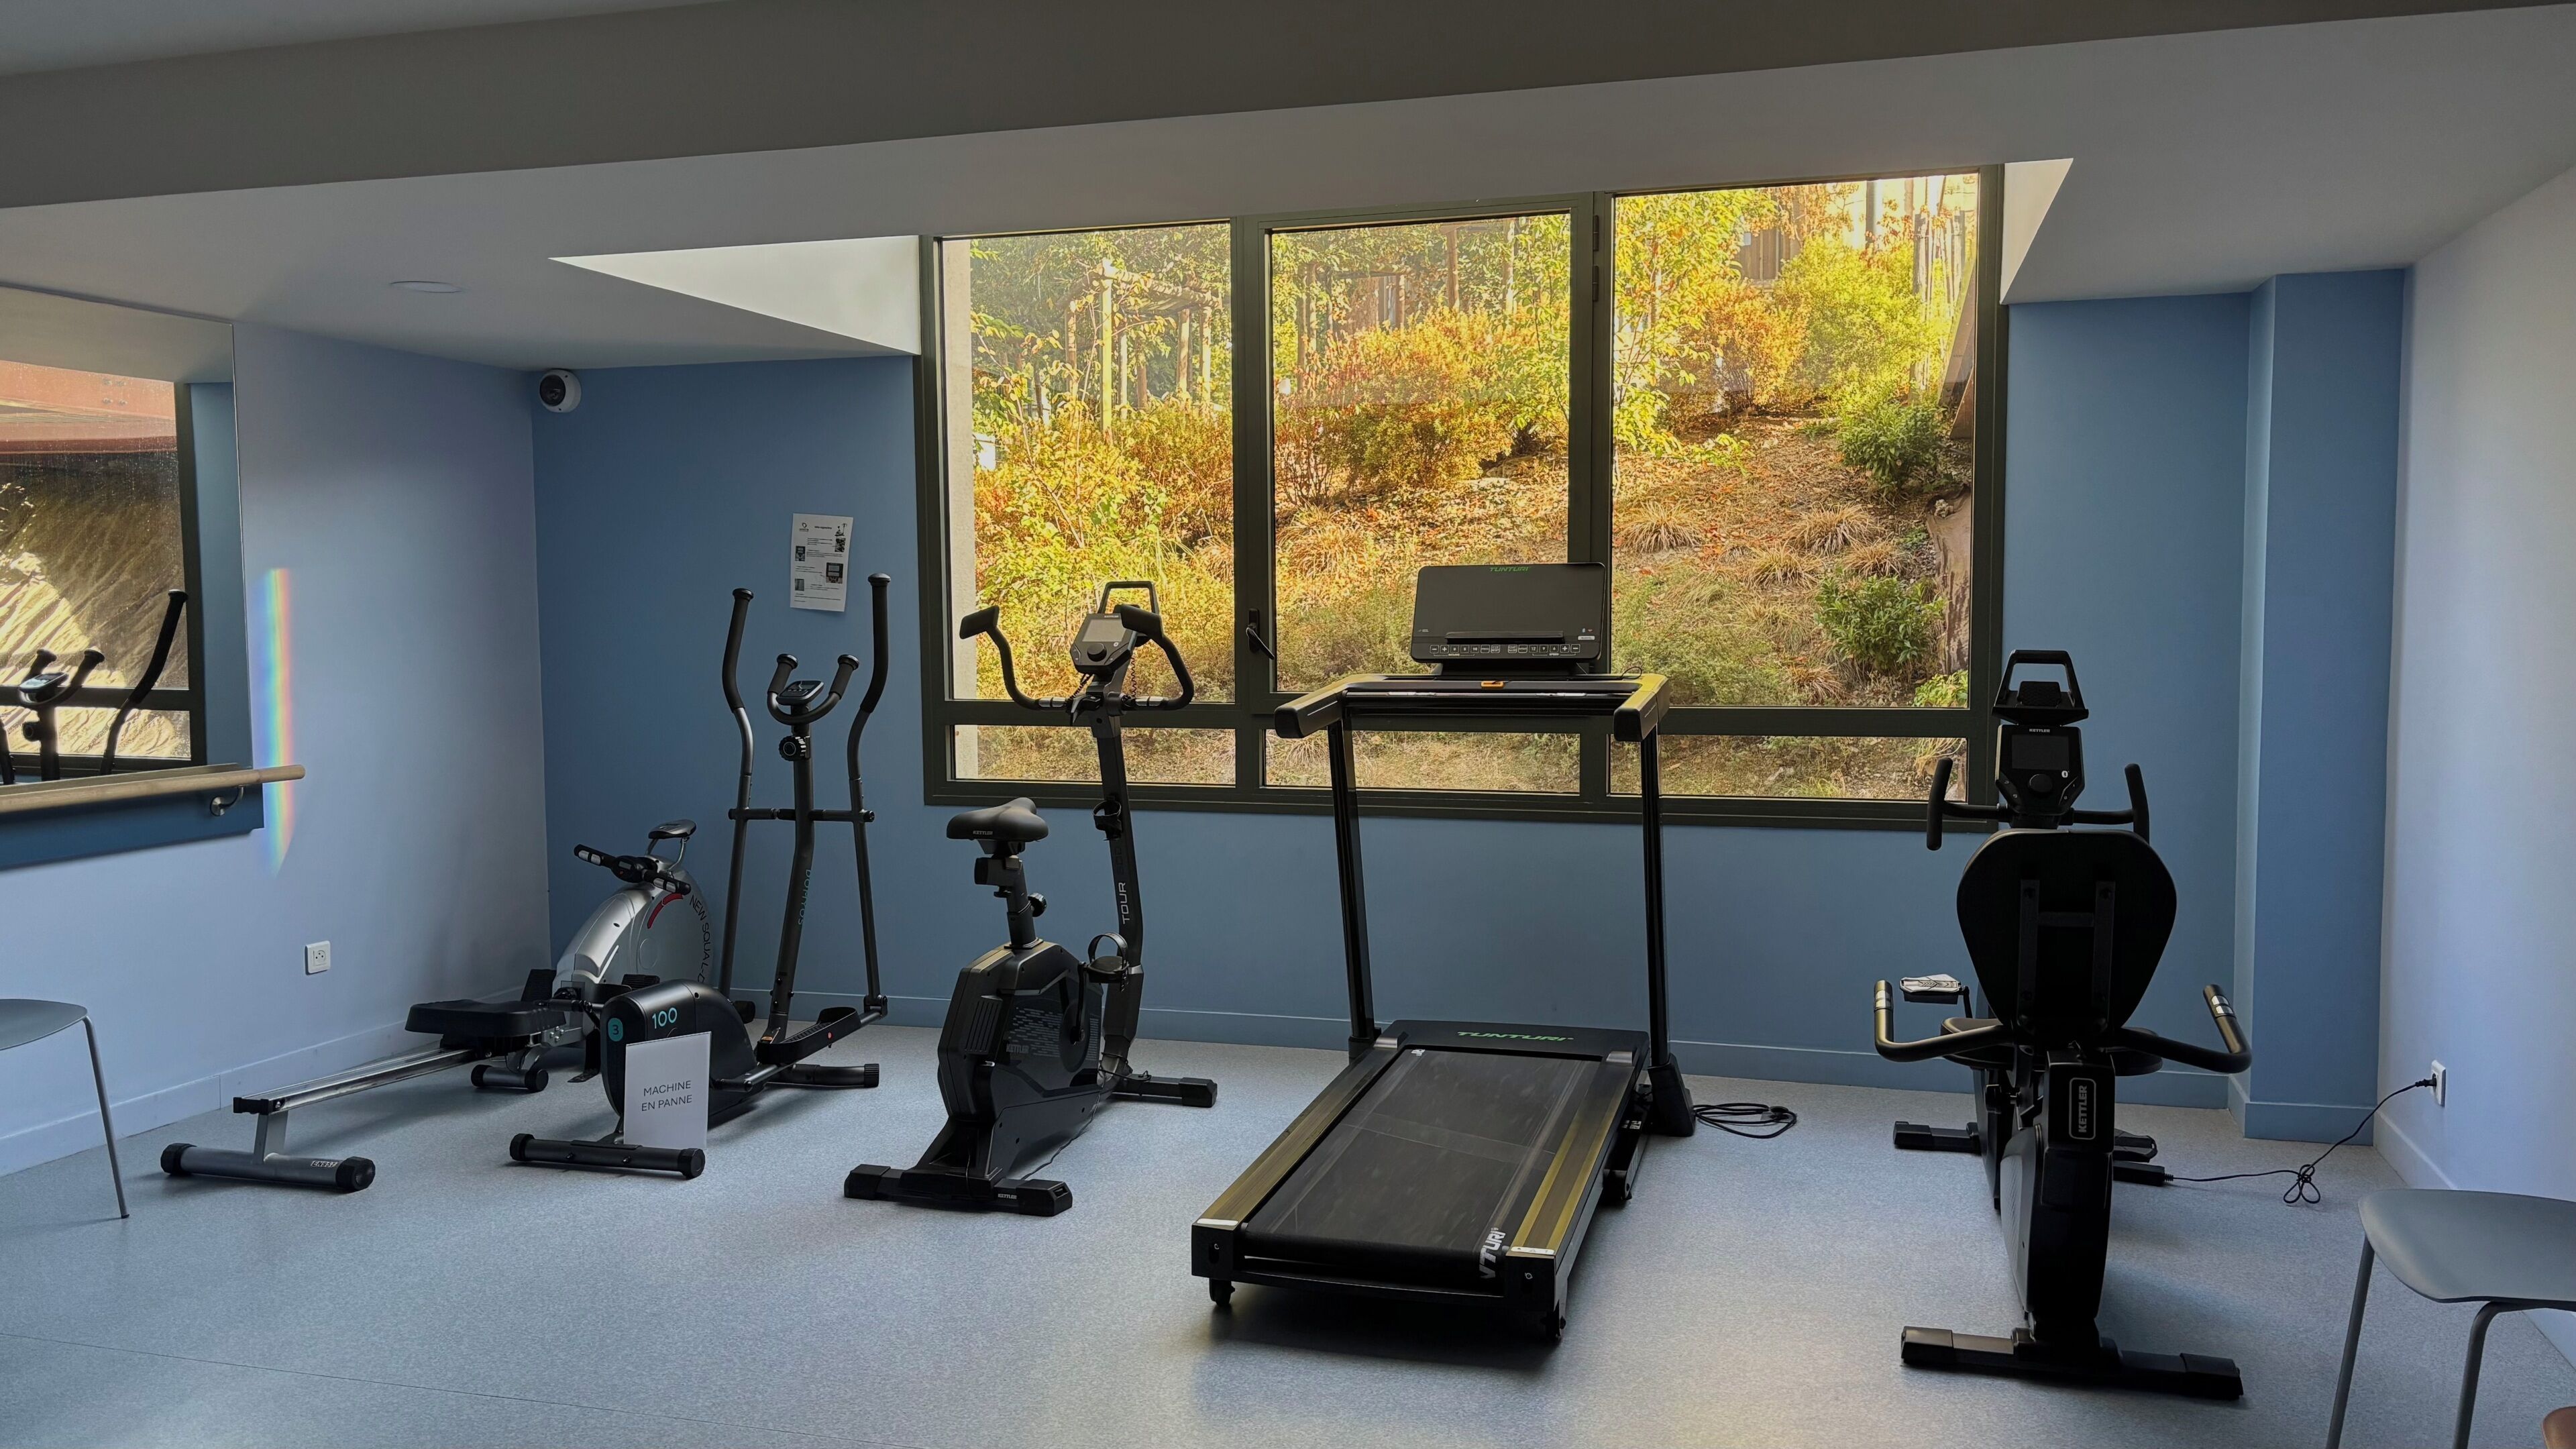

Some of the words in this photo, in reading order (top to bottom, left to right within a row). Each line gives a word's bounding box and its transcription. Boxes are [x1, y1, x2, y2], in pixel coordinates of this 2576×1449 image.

[689, 895, 708, 921] NEW
[1118, 881, 1130, 925] TOUR
[651, 1007, 678, 1029] 100
[612, 1024, 620, 1035] 3
[1457, 1031, 1568, 1041] TUNTURI
[643, 1080, 692, 1097] MACHINE
[641, 1101, 655, 1112] EN
[658, 1094, 692, 1109] PANNE
[2078, 1085, 2088, 1133] KETTLER
